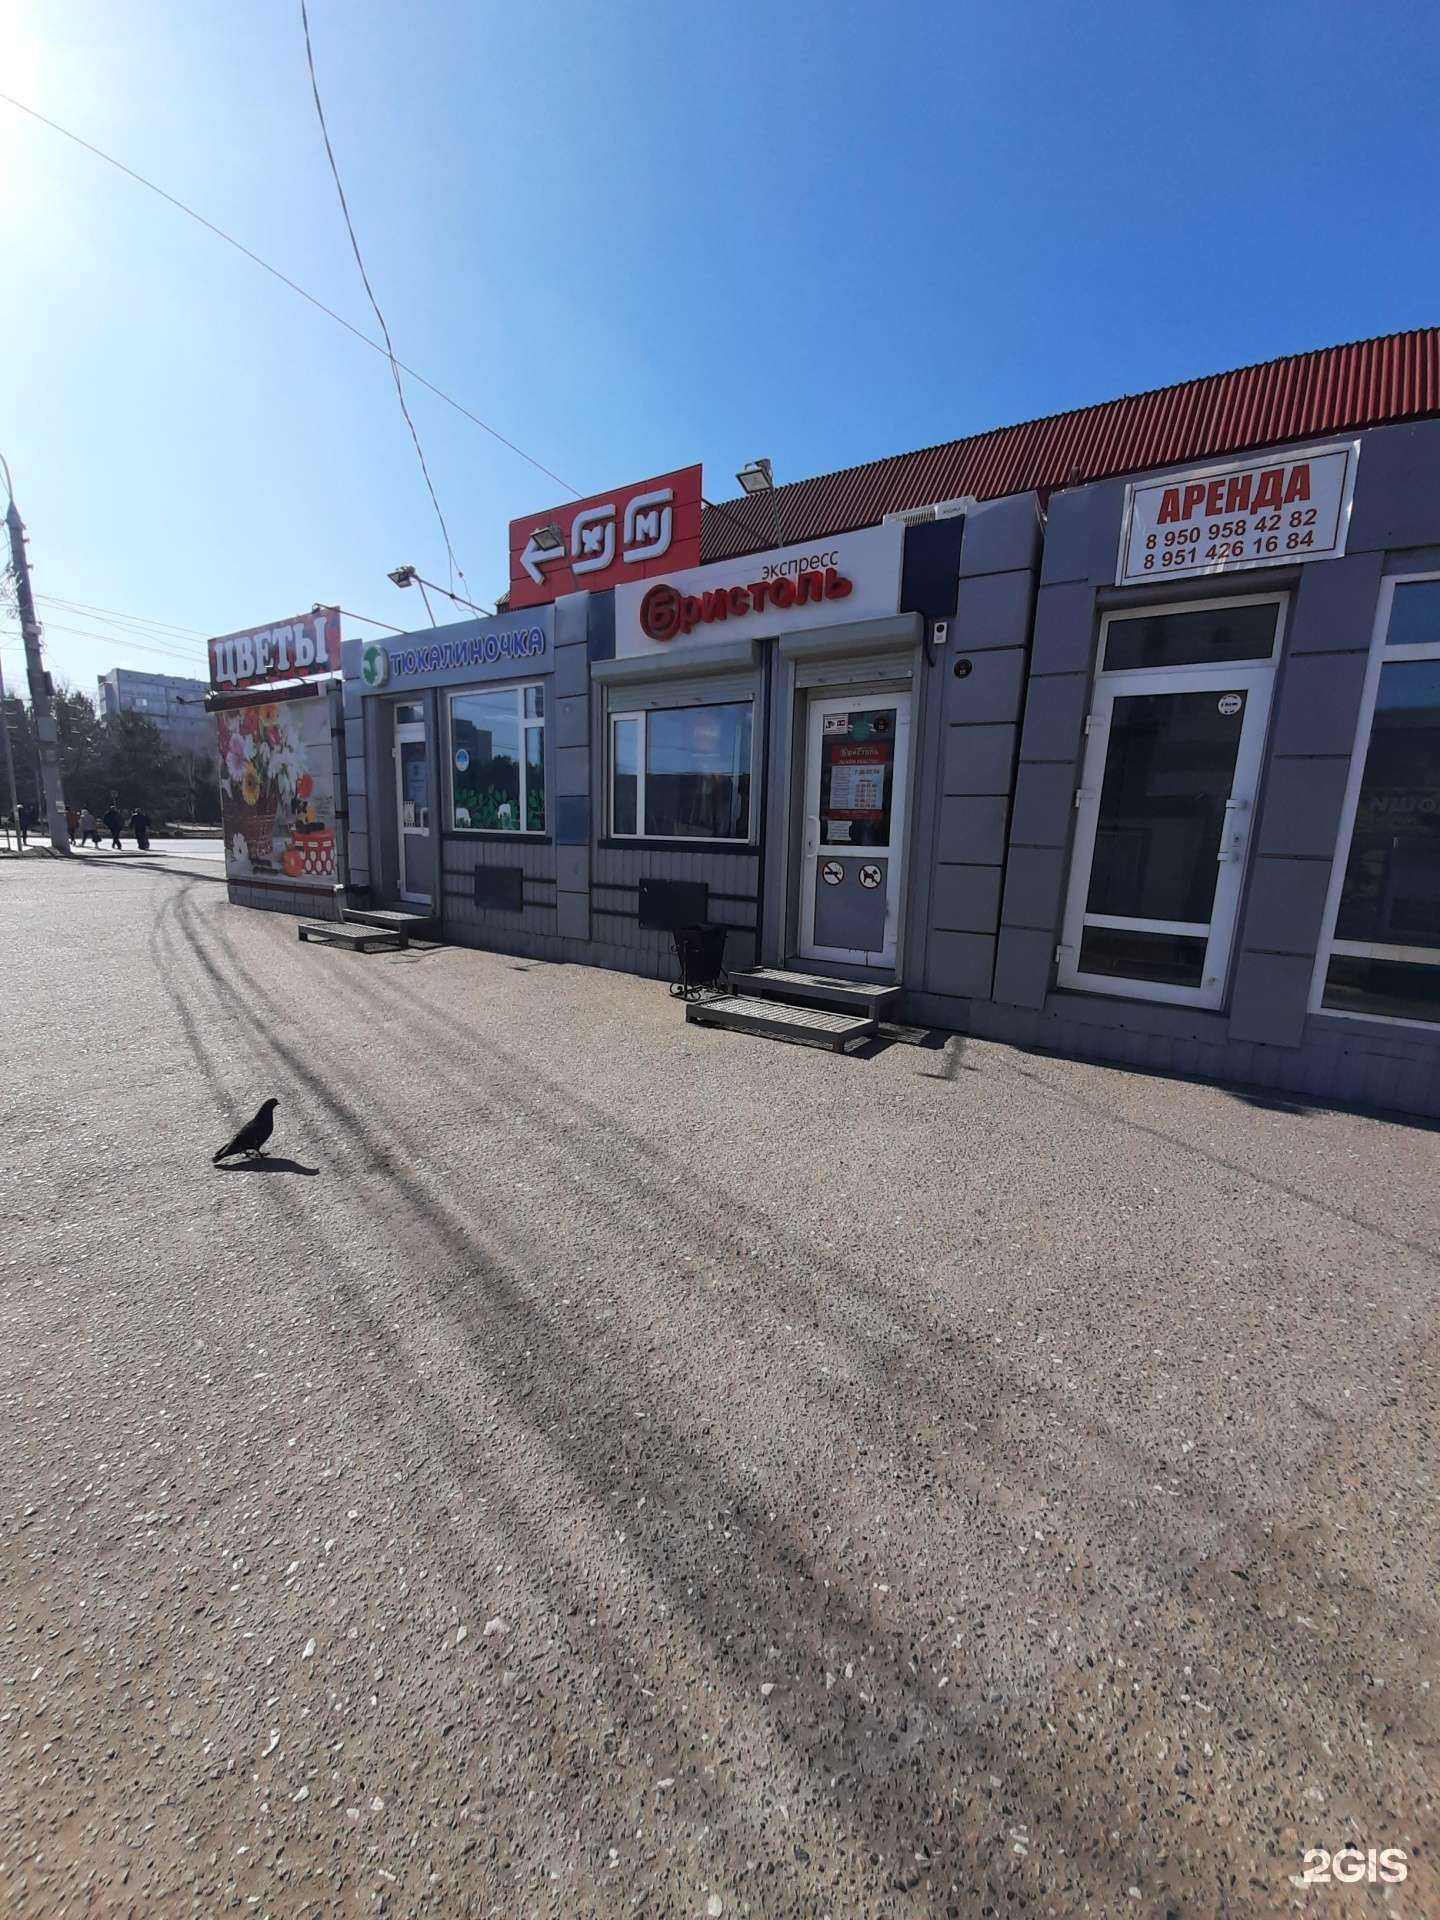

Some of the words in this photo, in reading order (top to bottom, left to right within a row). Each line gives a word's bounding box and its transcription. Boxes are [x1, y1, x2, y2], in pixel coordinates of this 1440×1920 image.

[1157, 464, 1311, 525] АРЕНДА
[1143, 553, 1155, 570] 8
[1162, 547, 1197, 567] 951
[1205, 540, 1244, 560] 426
[1253, 534, 1278, 554] 16
[1286, 529, 1314, 549] 84
[1146, 534, 1157, 550] 8
[1164, 527, 1201, 548] 950
[1208, 519, 1247, 541] 958
[1254, 513, 1281, 533] 42
[1289, 508, 1318, 528] 82
[761, 550, 839, 580] экспресс
[214, 616, 328, 686] ЦВЕТЫ
[389, 626, 546, 677] ТЮКАЛИНОЧКА
